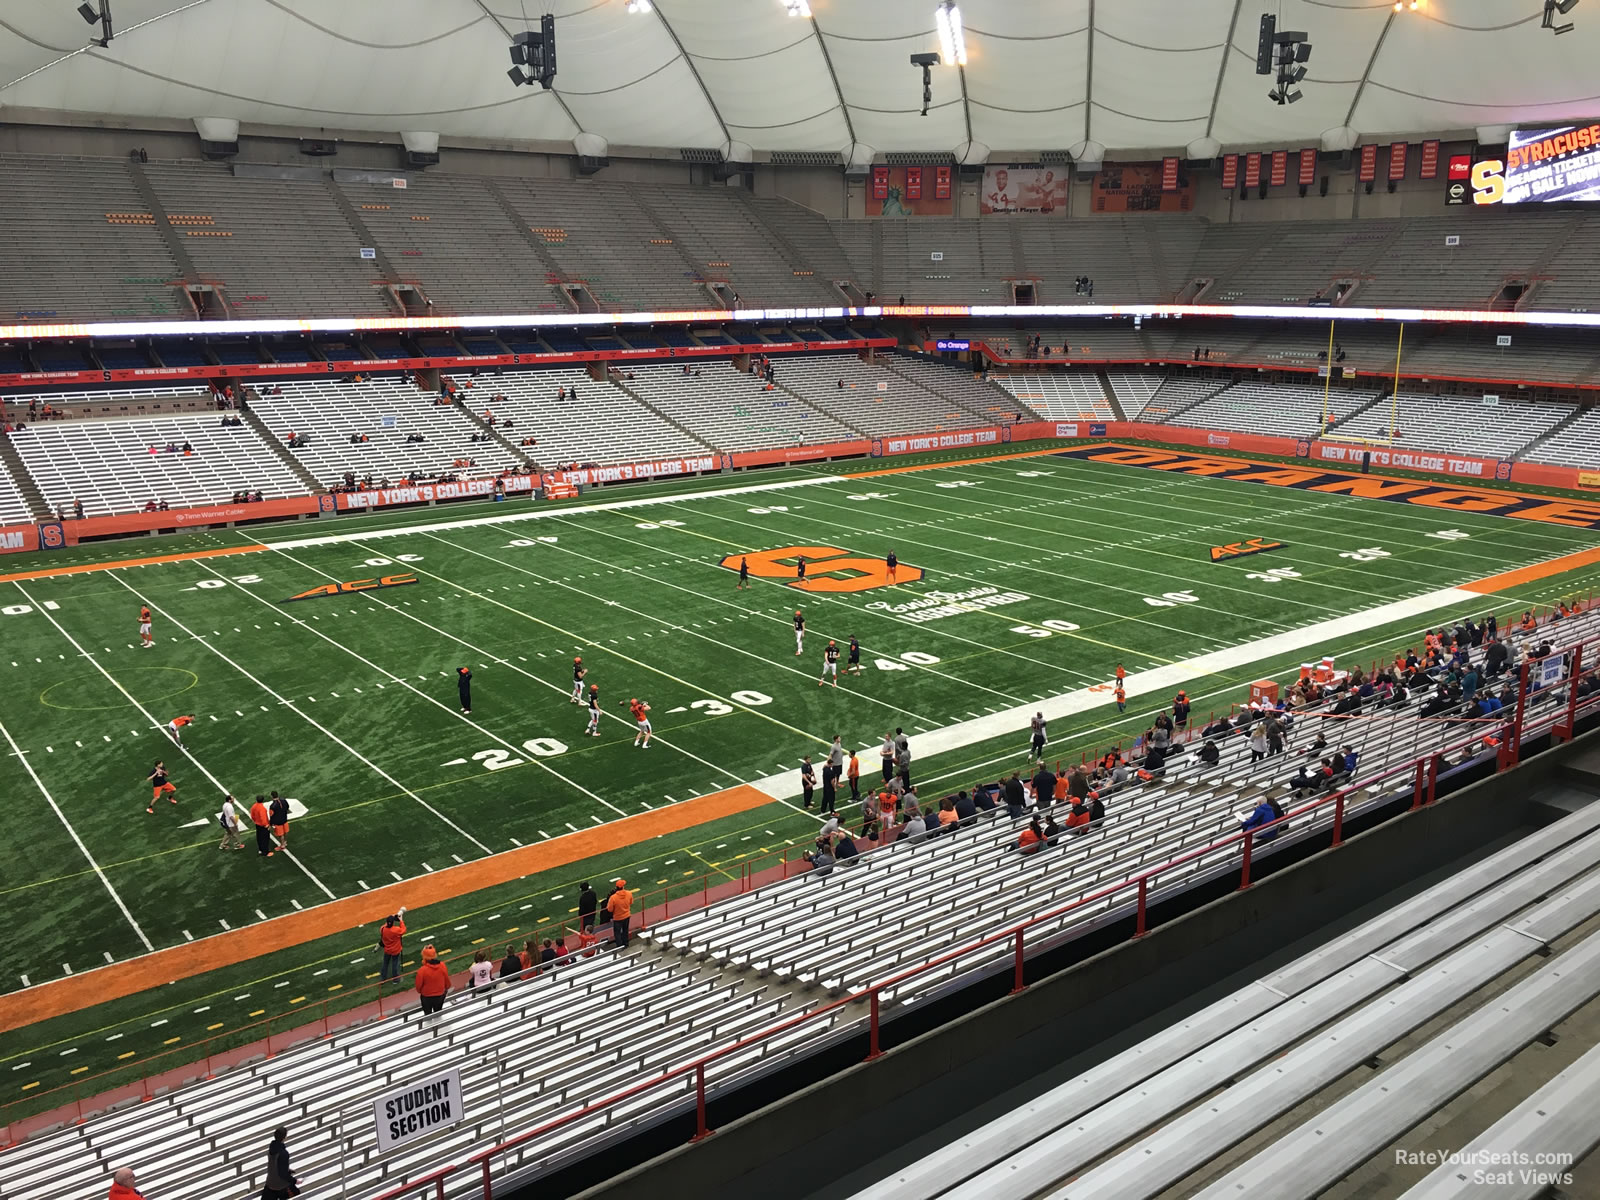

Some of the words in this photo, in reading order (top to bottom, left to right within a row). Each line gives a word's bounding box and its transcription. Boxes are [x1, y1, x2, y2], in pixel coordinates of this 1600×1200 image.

[1507, 125, 1600, 169] SYRACUSE
[1471, 160, 1505, 205] S
[1532, 174, 1566, 196] SALE
[882, 306, 927, 315] SYRACUSE
[928, 306, 969, 315] FOOTBALL
[938, 341, 947, 349] Go
[949, 341, 969, 350] Orange
[103, 370, 112, 381] S
[327, 362, 334, 372] S
[872, 441, 881, 456] S
[888, 440, 907, 453] NEW
[908, 436, 939, 450] YORK'S
[940, 433, 974, 448] COLLEGE
[975, 431, 996, 443] TEAM
[1297, 441, 1309, 457] S
[592, 466, 629, 483] YORK'S
[635, 461, 683, 479] COLLEGE
[684, 457, 713, 472] TEAM
[722, 456, 731, 469] S
[1321, 445, 1347, 460] NEW
[1348, 448, 1390, 465] YOK'S
[1392, 452, 1445, 470] COLLEGE
[1447, 459, 1483, 475] TEAM
[1497, 463, 1511, 480] S
[347, 490, 379, 508] NEW
[382, 485, 433, 504] YORK'S
[436, 479, 494, 499] COLLEGE
[496, 476, 531, 491] EAM
[1088, 451, 1600, 528] ORANGE
[323, 495, 336, 512] S
[184, 512, 201, 520] Time
[202, 510, 224, 518] Warner
[226, 508, 244, 516] Cable
[42, 525, 63, 547] S
[1425, 530, 1470, 541] 10
[1210, 537, 1290, 562] ACC
[1339, 549, 1392, 561] 20
[718, 546, 925, 593] S
[1245, 567, 1303, 583] 30
[196, 574, 264, 590] 20
[896, 601, 980, 623] LEGENDS
[966, 592, 1031, 612] FIELD
[1142, 591, 1200, 607] 40
[1010, 619, 1081, 638] 50
[873, 651, 941, 671] 40
[690, 690, 774, 716] 30
[462, 737, 569, 771] 20
[385, 1078, 450, 1120] STUDENT
[389, 1100, 451, 1140] SECTION
